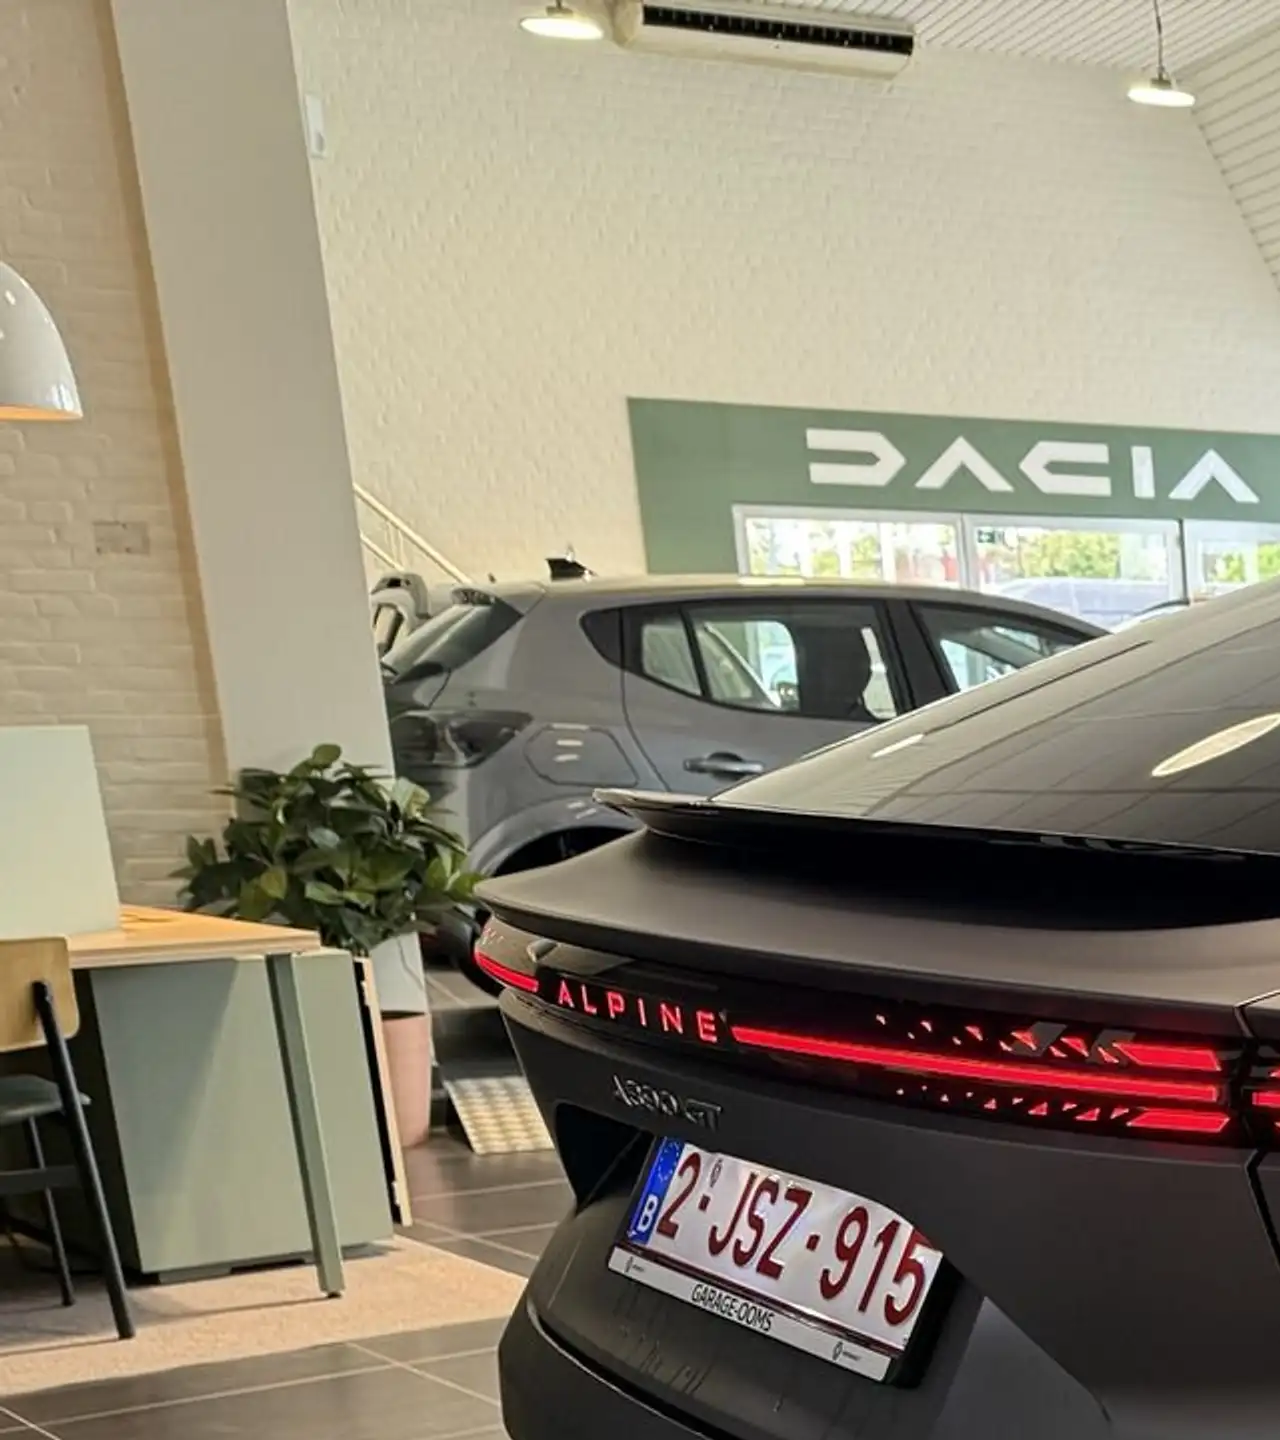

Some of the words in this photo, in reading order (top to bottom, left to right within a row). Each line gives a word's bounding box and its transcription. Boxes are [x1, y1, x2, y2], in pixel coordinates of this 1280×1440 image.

[805, 428, 1260, 503] DACIA
[557, 979, 718, 1044] ALPINE
[636, 1194, 658, 1233] B
